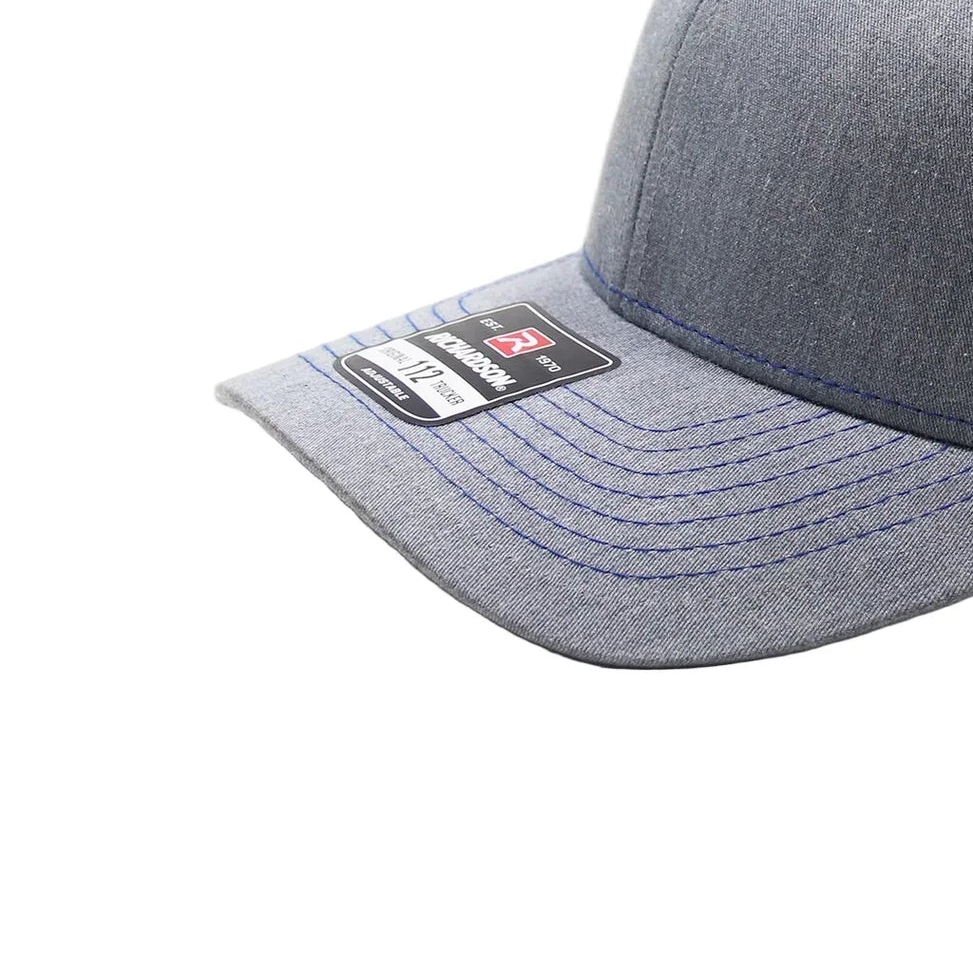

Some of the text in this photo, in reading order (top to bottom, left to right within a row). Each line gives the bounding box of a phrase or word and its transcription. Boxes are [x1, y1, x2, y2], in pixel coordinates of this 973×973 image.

[480, 318, 504, 331] EST.
[535, 355, 562, 373] 1970
[360, 367, 410, 401] ADJUSTABLE
[397, 360, 465, 406] 112 TRUCKER
